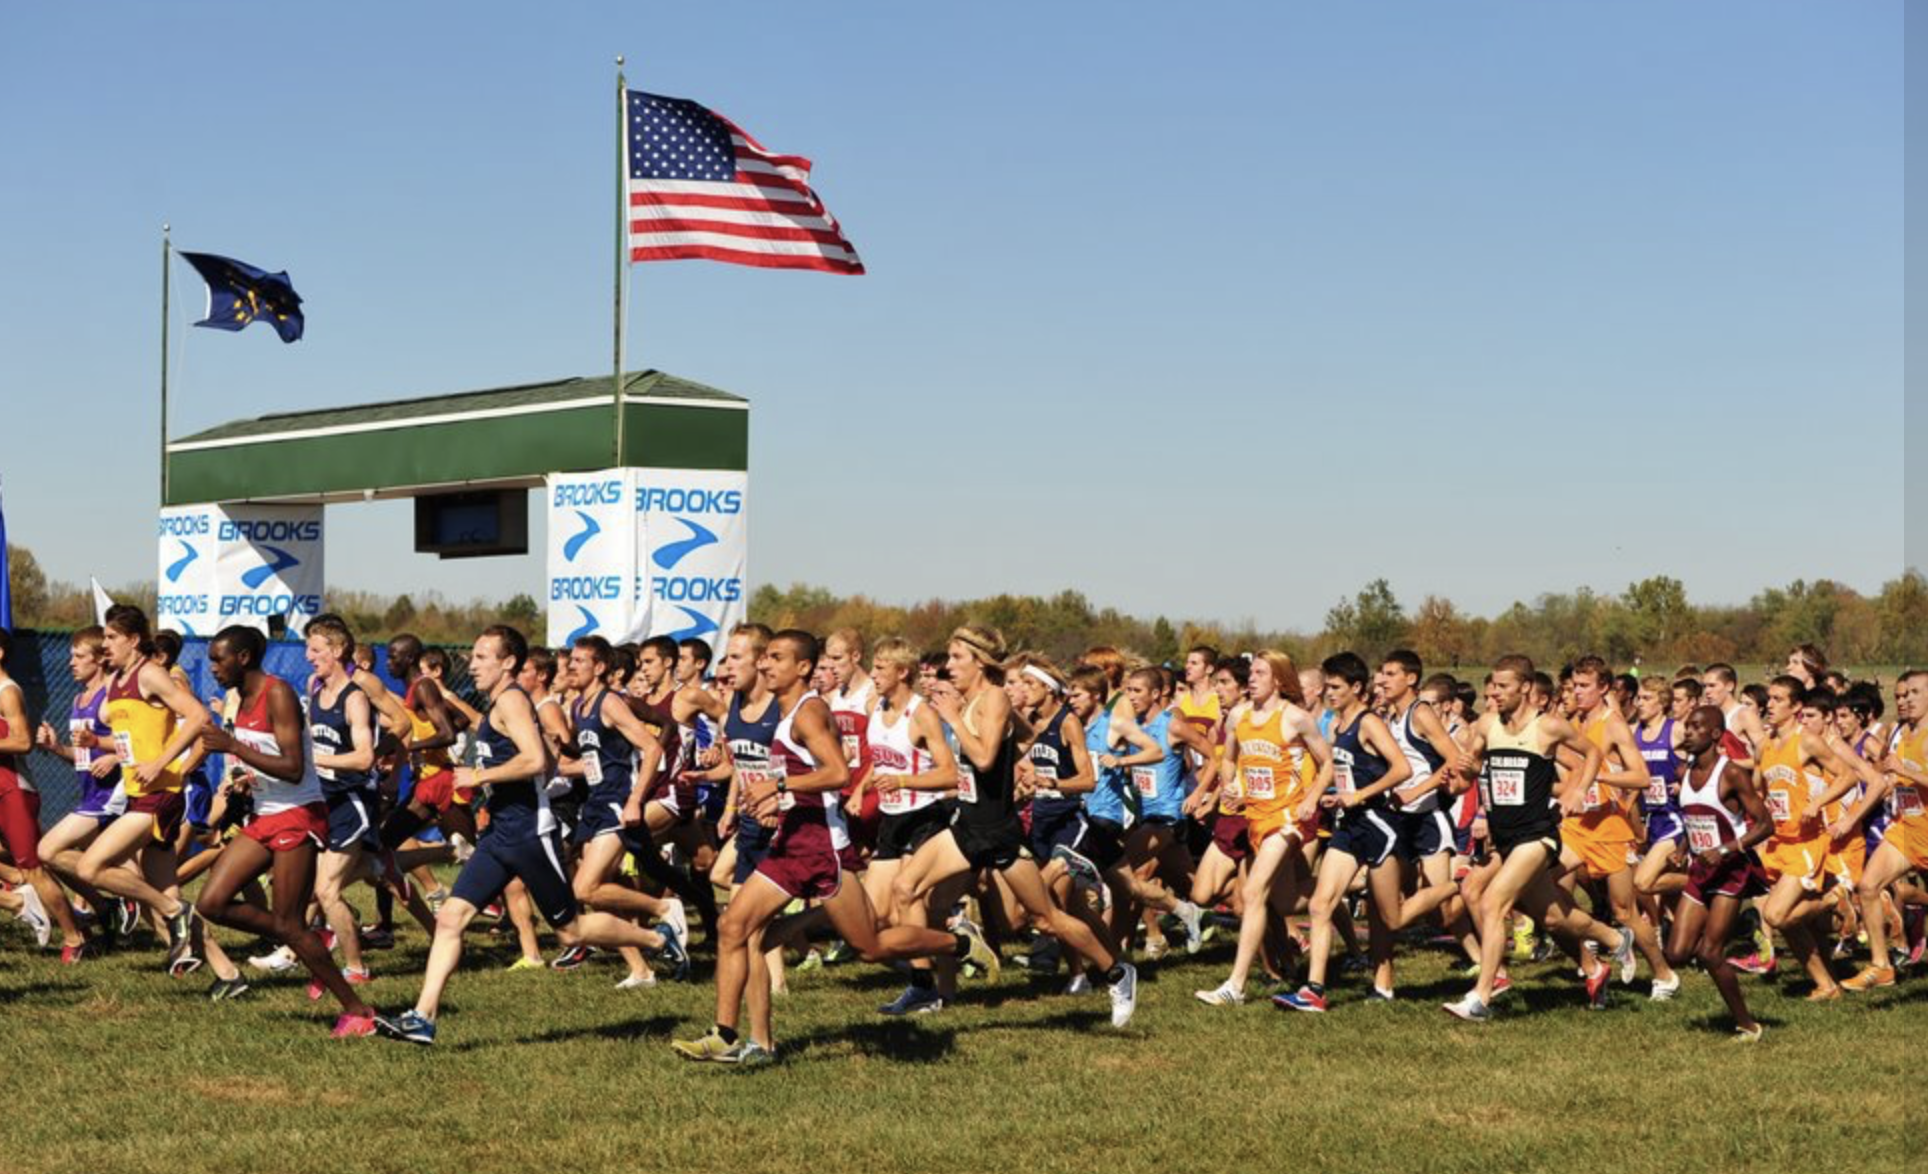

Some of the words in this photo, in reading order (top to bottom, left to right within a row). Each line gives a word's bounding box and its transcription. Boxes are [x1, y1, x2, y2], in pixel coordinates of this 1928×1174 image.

[554, 481, 622, 507] BROOKS
[636, 488, 742, 514] BROOKS
[160, 515, 209, 536] BROOKS
[218, 521, 320, 541] BROOKS
[551, 576, 621, 600] BROOKS
[652, 576, 741, 601] ROOKS
[158, 594, 208, 614] BROOKS
[219, 595, 320, 615] BROOKS
[1496, 780, 1517, 797] 324
